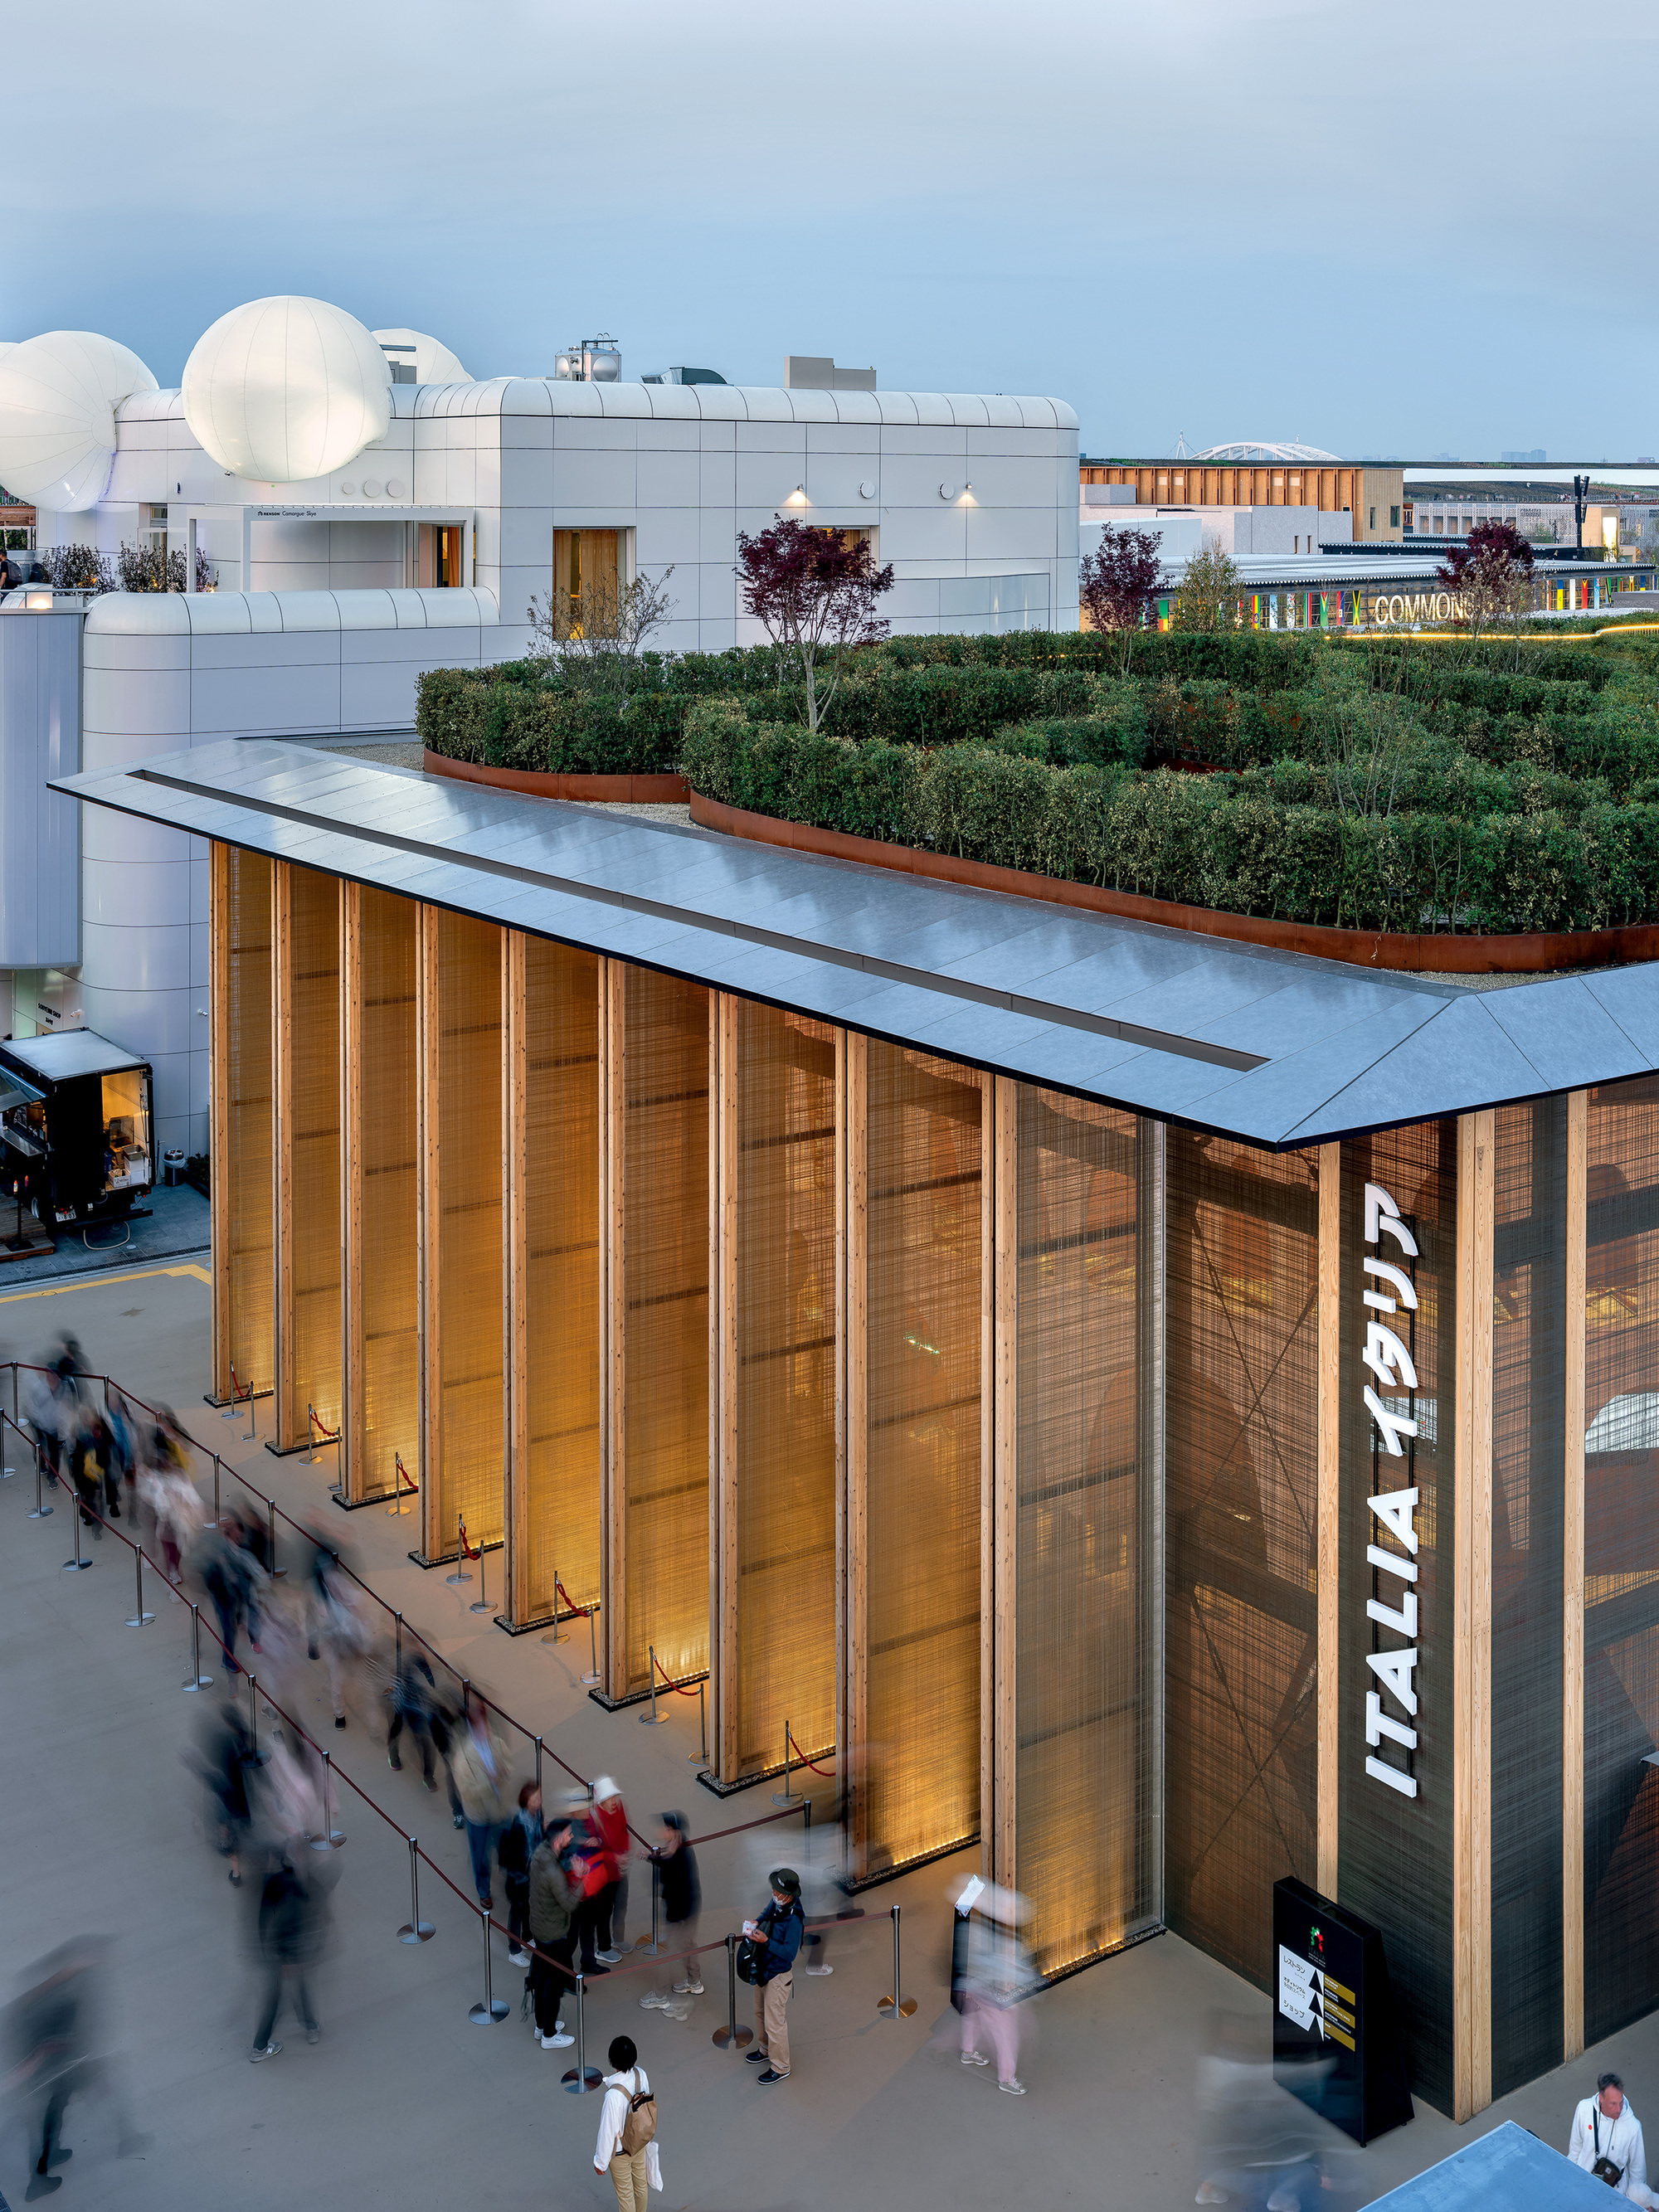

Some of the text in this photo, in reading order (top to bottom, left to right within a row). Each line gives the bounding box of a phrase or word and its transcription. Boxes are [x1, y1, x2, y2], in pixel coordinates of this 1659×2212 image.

[1375, 592, 1475, 625] COMMON
[1363, 1183, 1419, 1457] イタリア
[1365, 1485, 1418, 1798] ITALIA
[1283, 1955, 1306, 1974] レストラン
[1283, 1999, 1306, 2019] ショップ
